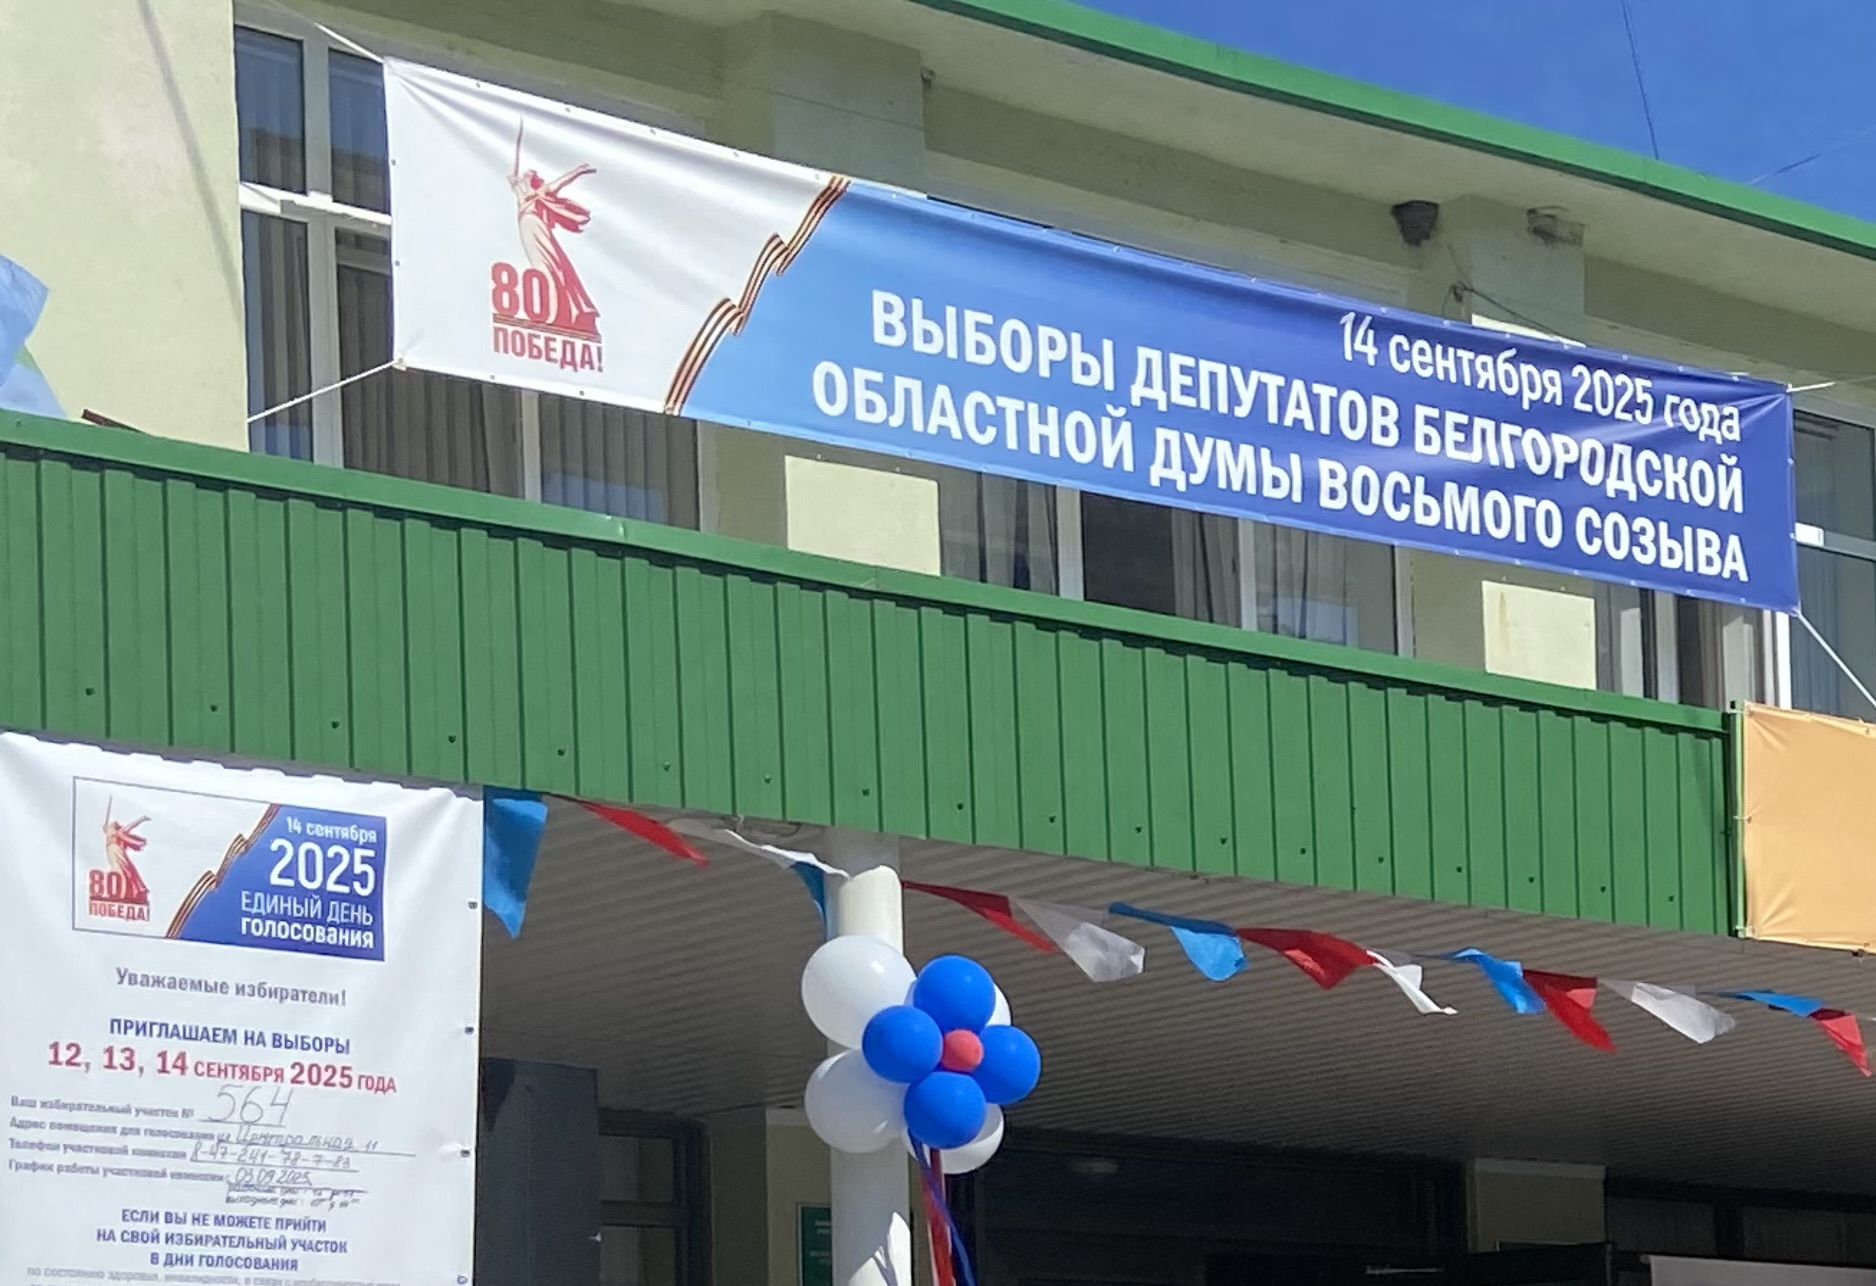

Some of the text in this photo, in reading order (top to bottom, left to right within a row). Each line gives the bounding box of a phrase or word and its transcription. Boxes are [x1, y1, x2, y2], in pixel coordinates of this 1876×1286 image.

[491, 262, 550, 323] 80
[493, 326, 604, 373] ПОБЕДА!
[1340, 312, 1741, 444] 14 сентября 2025 года
[872, 289, 1743, 514] ВЫБОРЫ ДЕПУТАТОВ БЕЛГОРОДСКОЙ
[812, 360, 1749, 582] ОБЛАСТНОЙ ДУМЫ ВОСЬМОГО СОЗЫВА
[286, 816, 378, 844] 14 сентября
[89, 870, 122, 899] 80
[269, 839, 376, 897] 2025
[89, 902, 150, 923] ПОБЕДА!
[241, 890, 373, 927] ЕДИНЫЙ ДЕНЬ
[240, 918, 374, 948] голосования
[116, 967, 346, 1007] Уважаемые избиратели!
[110, 1018, 350, 1055] ПРИГЛАШАЕМ НА ВЫБОРЫ
[48, 1041, 397, 1095] 12, 13, 14 СЕНТЯБРЯ 2025 ГОДА
[209, 1084, 295, 1124] 564
[121, 1208, 327, 1233] ЕСЛИ ВЫ НЕ МОЖЕТЕ ПРИЙТИ
[96, 1227, 348, 1255] НА СВОЙ ИЗБИРАТЕЛЬНЫЙ УЧАСТОК
[150, 1252, 299, 1272] В ДНИ ГОЛОСОВАНИЯ
